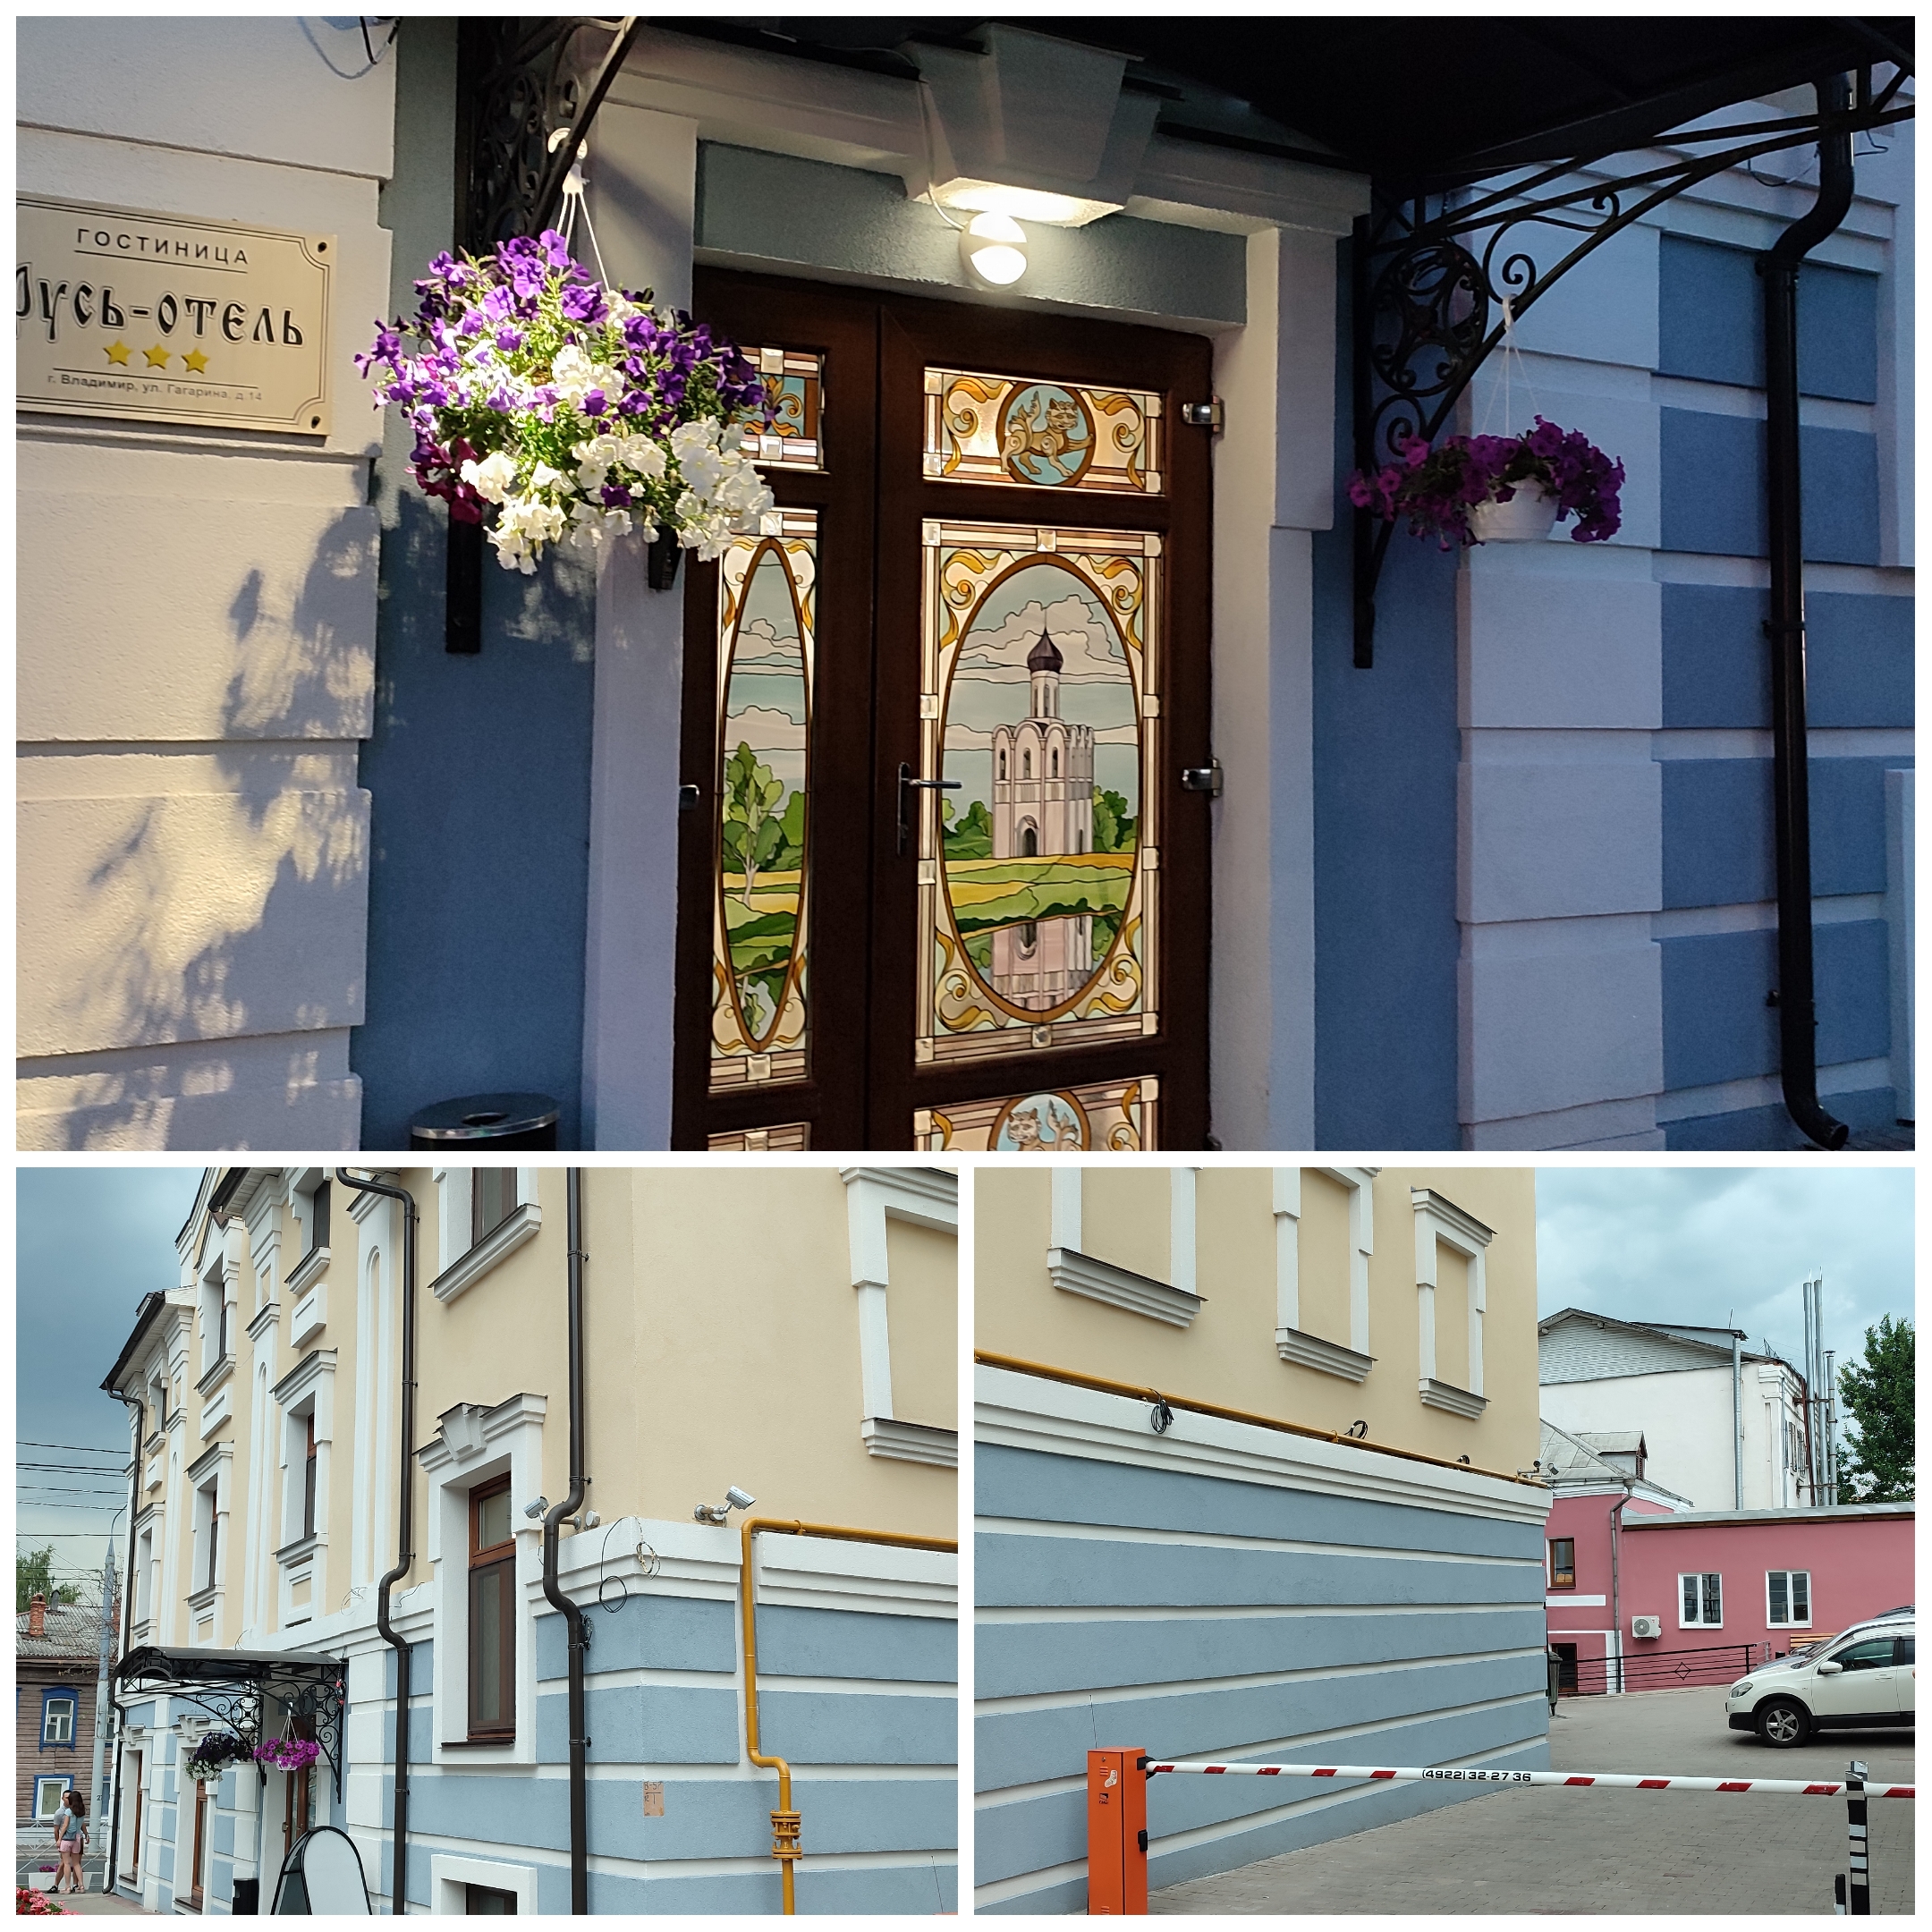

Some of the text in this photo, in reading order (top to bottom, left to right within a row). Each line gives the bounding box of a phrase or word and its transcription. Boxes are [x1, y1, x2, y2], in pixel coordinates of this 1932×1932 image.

[77, 228, 249, 265] ГОСТИНИЦА
[47, 375, 56, 384] г.
[61, 374, 139, 392] Владимир,
[142, 383, 163, 394] ул.
[167, 384, 231, 399] Гагарина,
